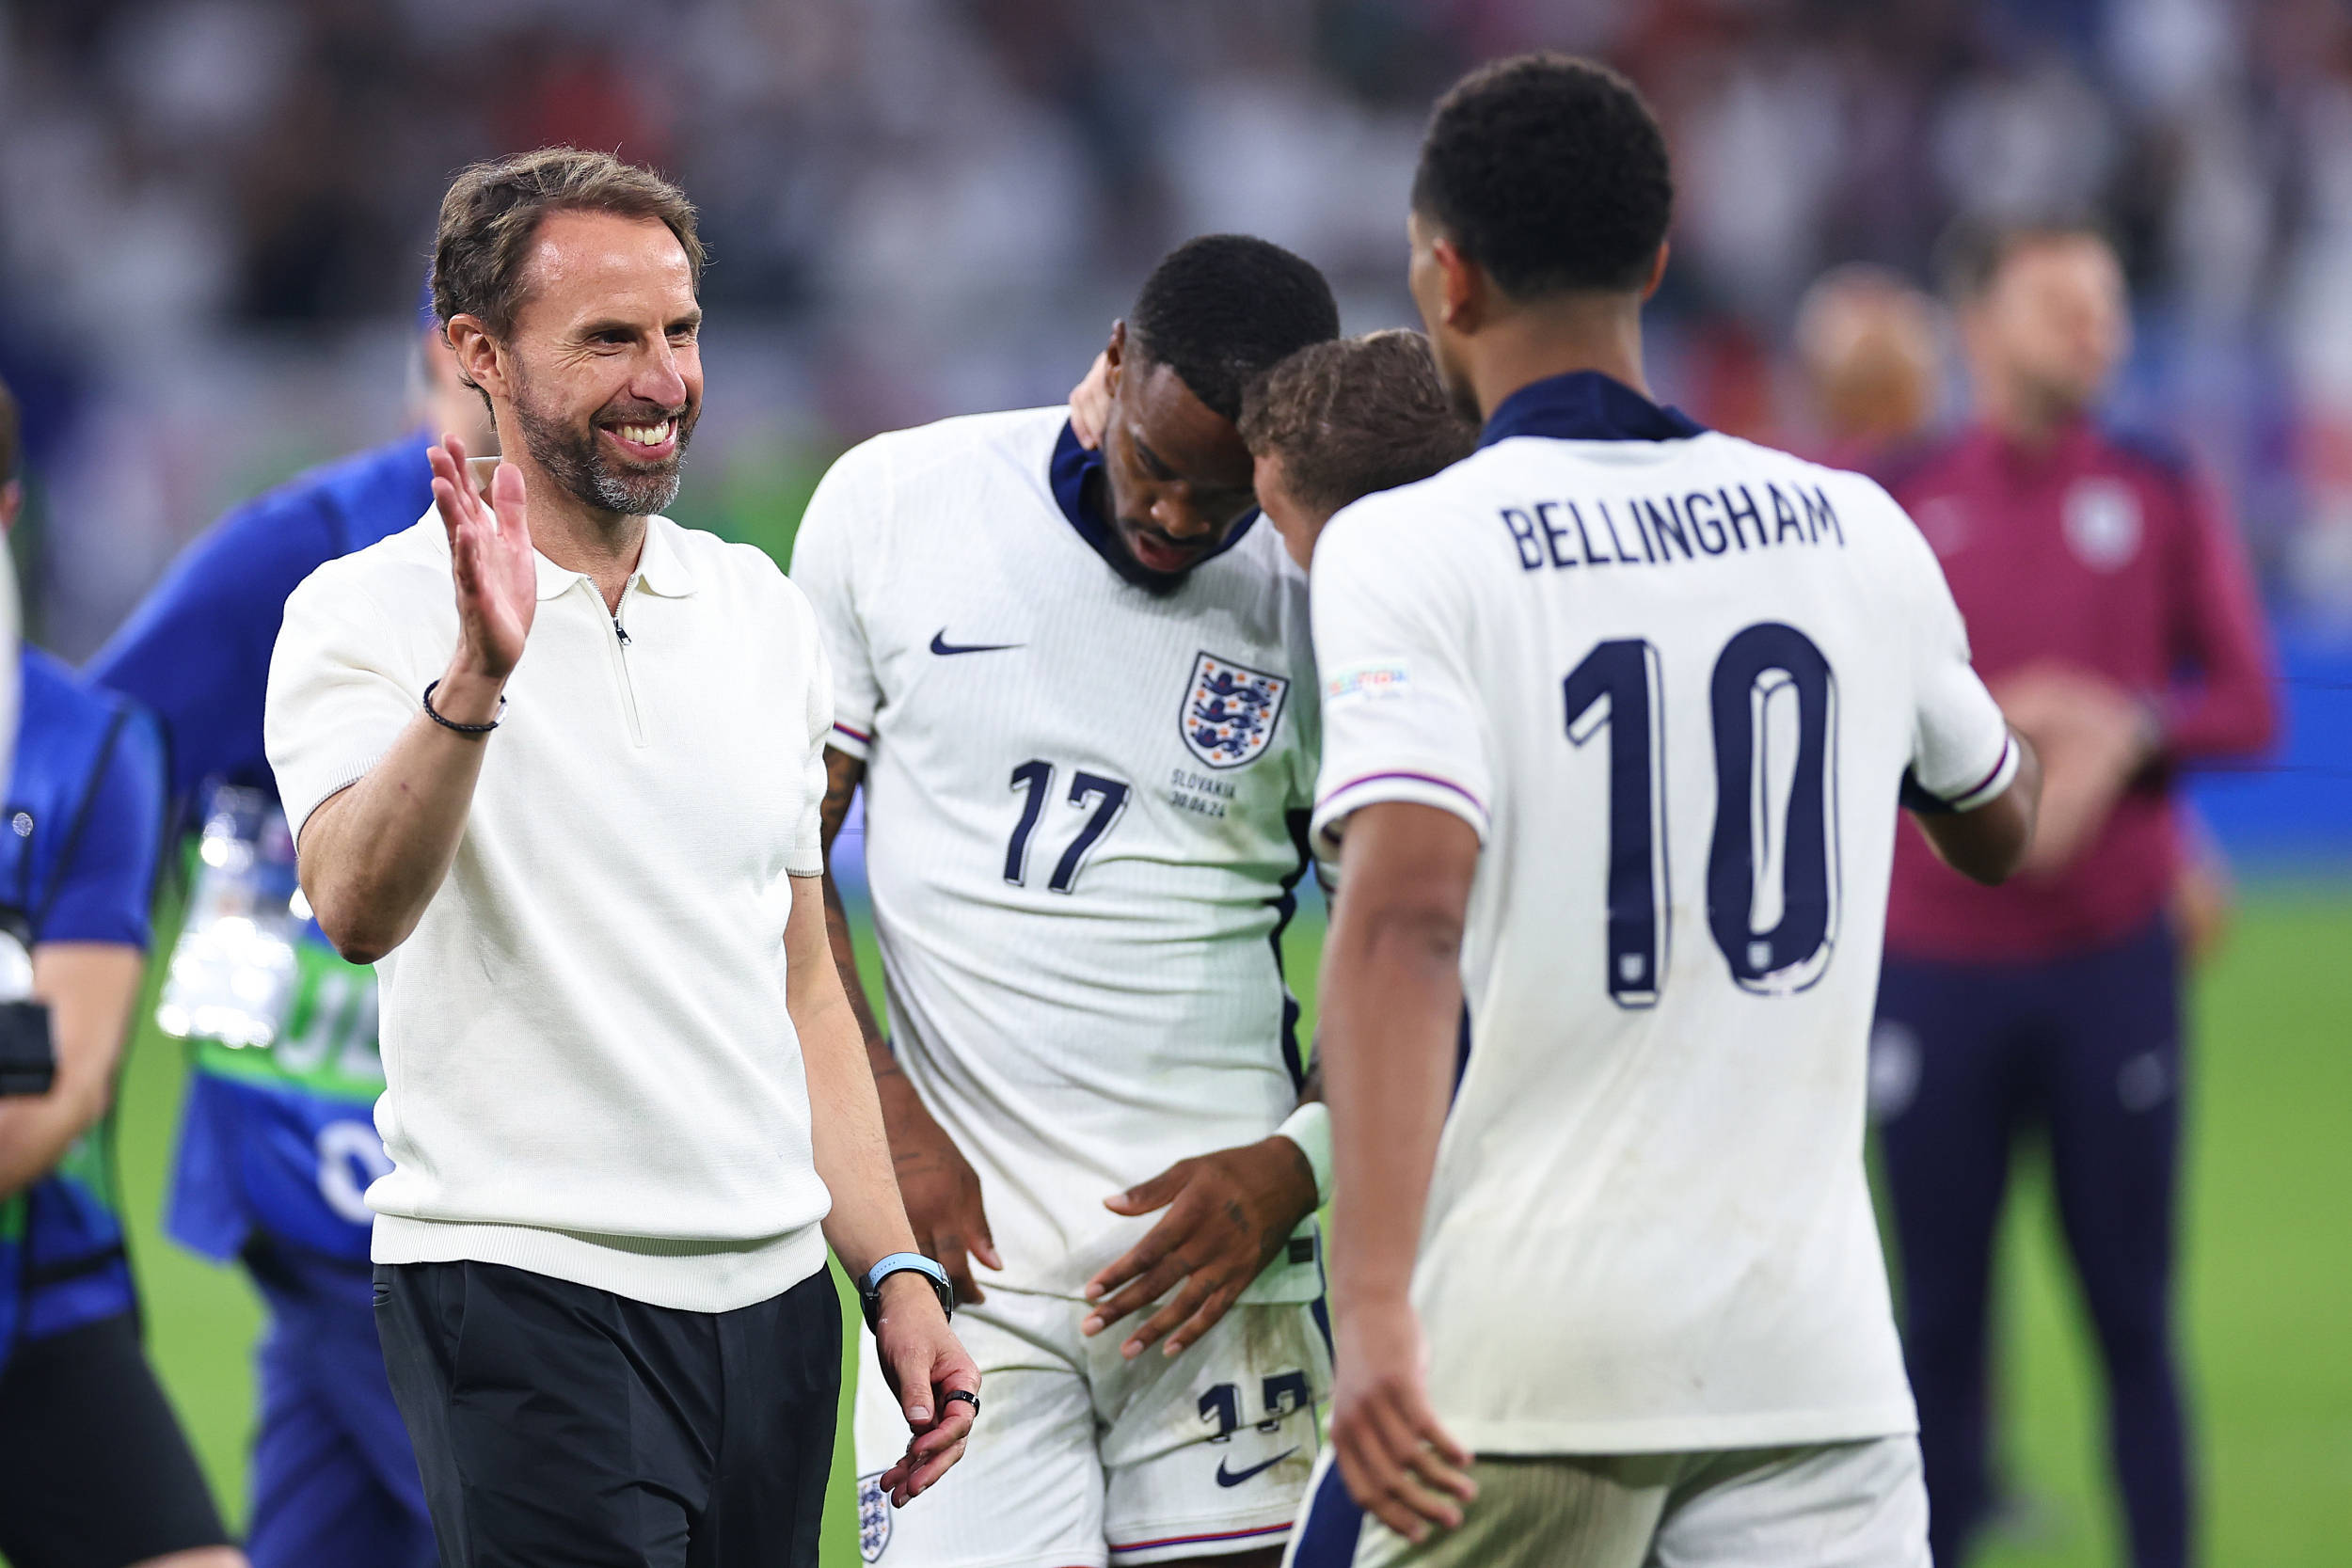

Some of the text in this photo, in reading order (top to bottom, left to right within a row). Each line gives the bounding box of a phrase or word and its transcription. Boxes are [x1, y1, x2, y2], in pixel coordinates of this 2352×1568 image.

[1500, 480, 1845, 572] BELLINGHAM
[1003, 758, 1133, 895] 17
[1171, 768, 1236, 800] SLOVAKIA
[1563, 620, 1841, 1010] 10
